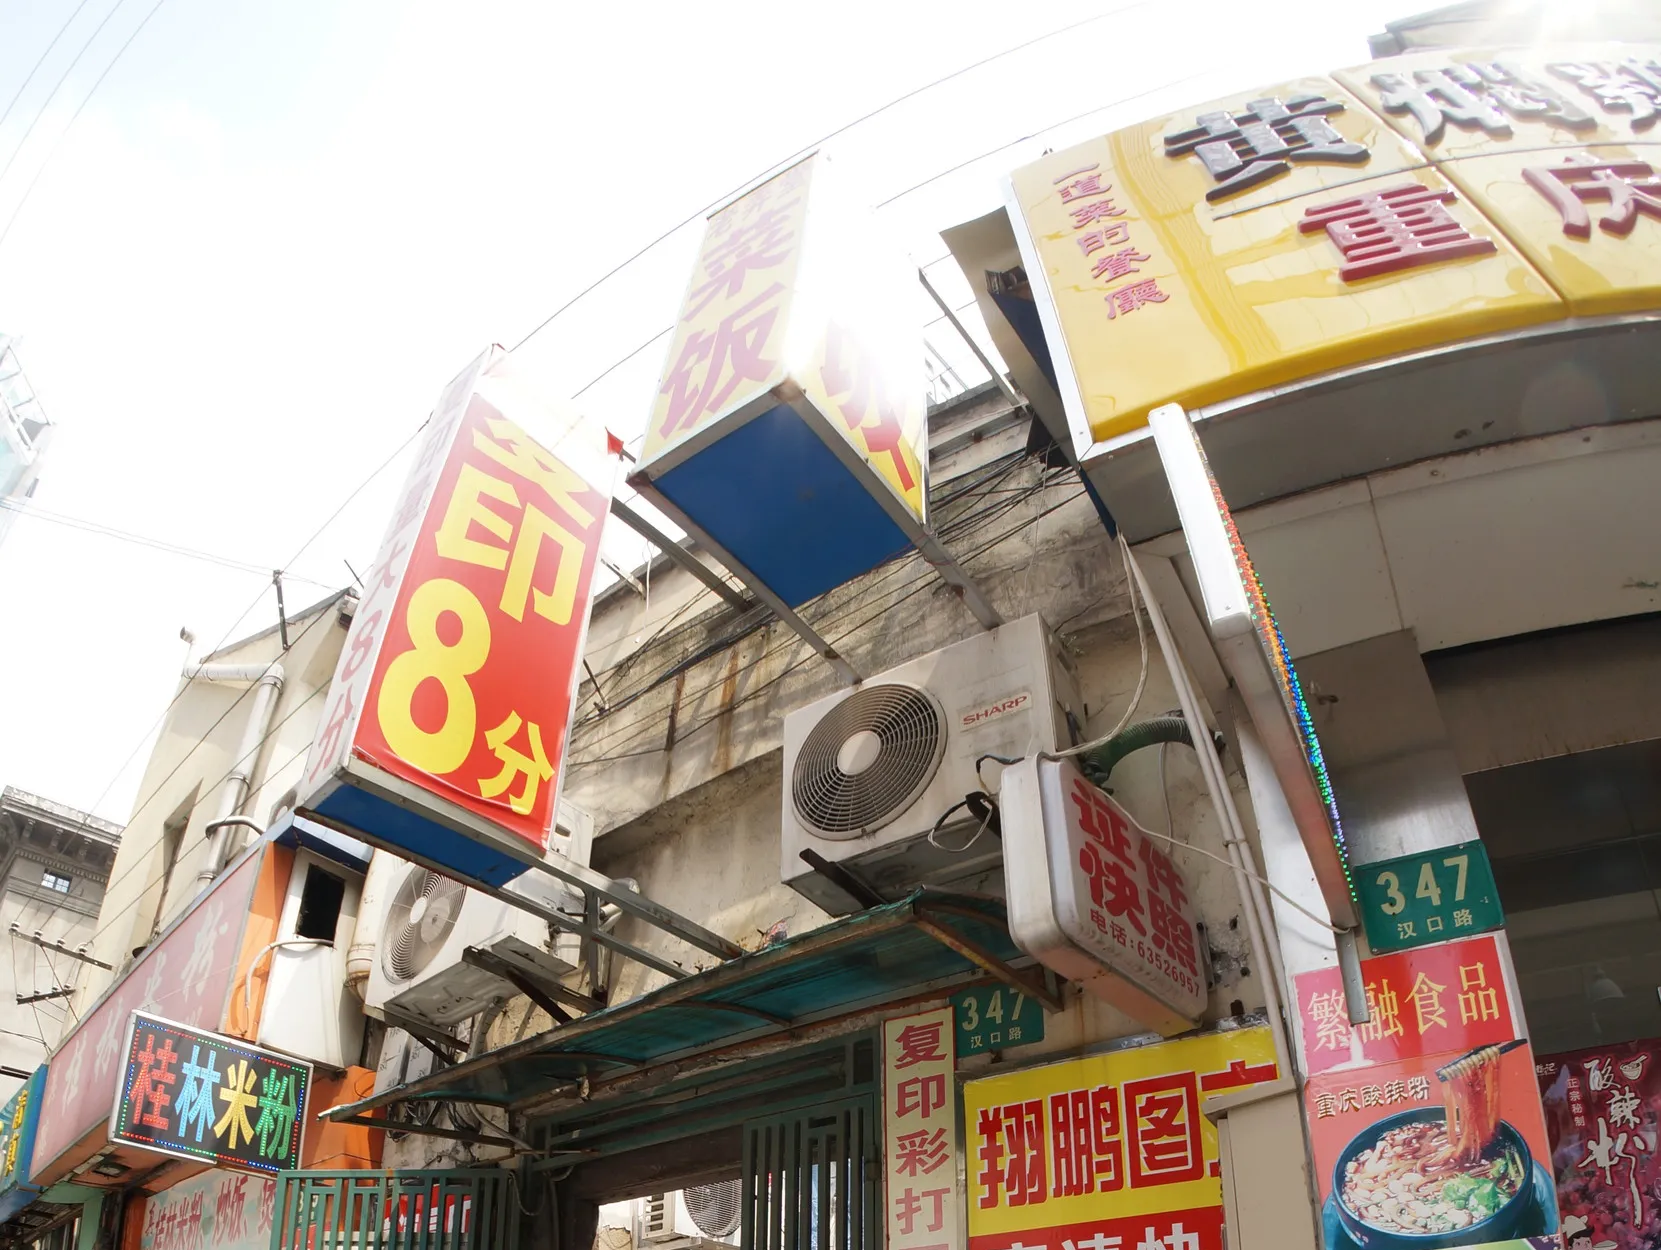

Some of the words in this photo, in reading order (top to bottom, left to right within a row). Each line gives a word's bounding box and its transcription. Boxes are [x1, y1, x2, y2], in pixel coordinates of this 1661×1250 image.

[1053, 162, 1170, 320] 一道菜的餐廳
[659, 195, 803, 441] 菜饭
[963, 695, 1027, 725] SHARP
[1071, 778, 1188, 912] 证件
[1376, 854, 1469, 916] 347
[1079, 841, 1199, 978] 快照
[1397, 908, 1473, 940] 汉口路
[962, 986, 1025, 1032] 347
[970, 1026, 1022, 1049] 汉口路
[128, 1033, 298, 1162] 桂林米粉
[1315, 1075, 1431, 1119] 重庆酸辣粉
[1577, 1057, 1647, 1229] 酸辣粉
